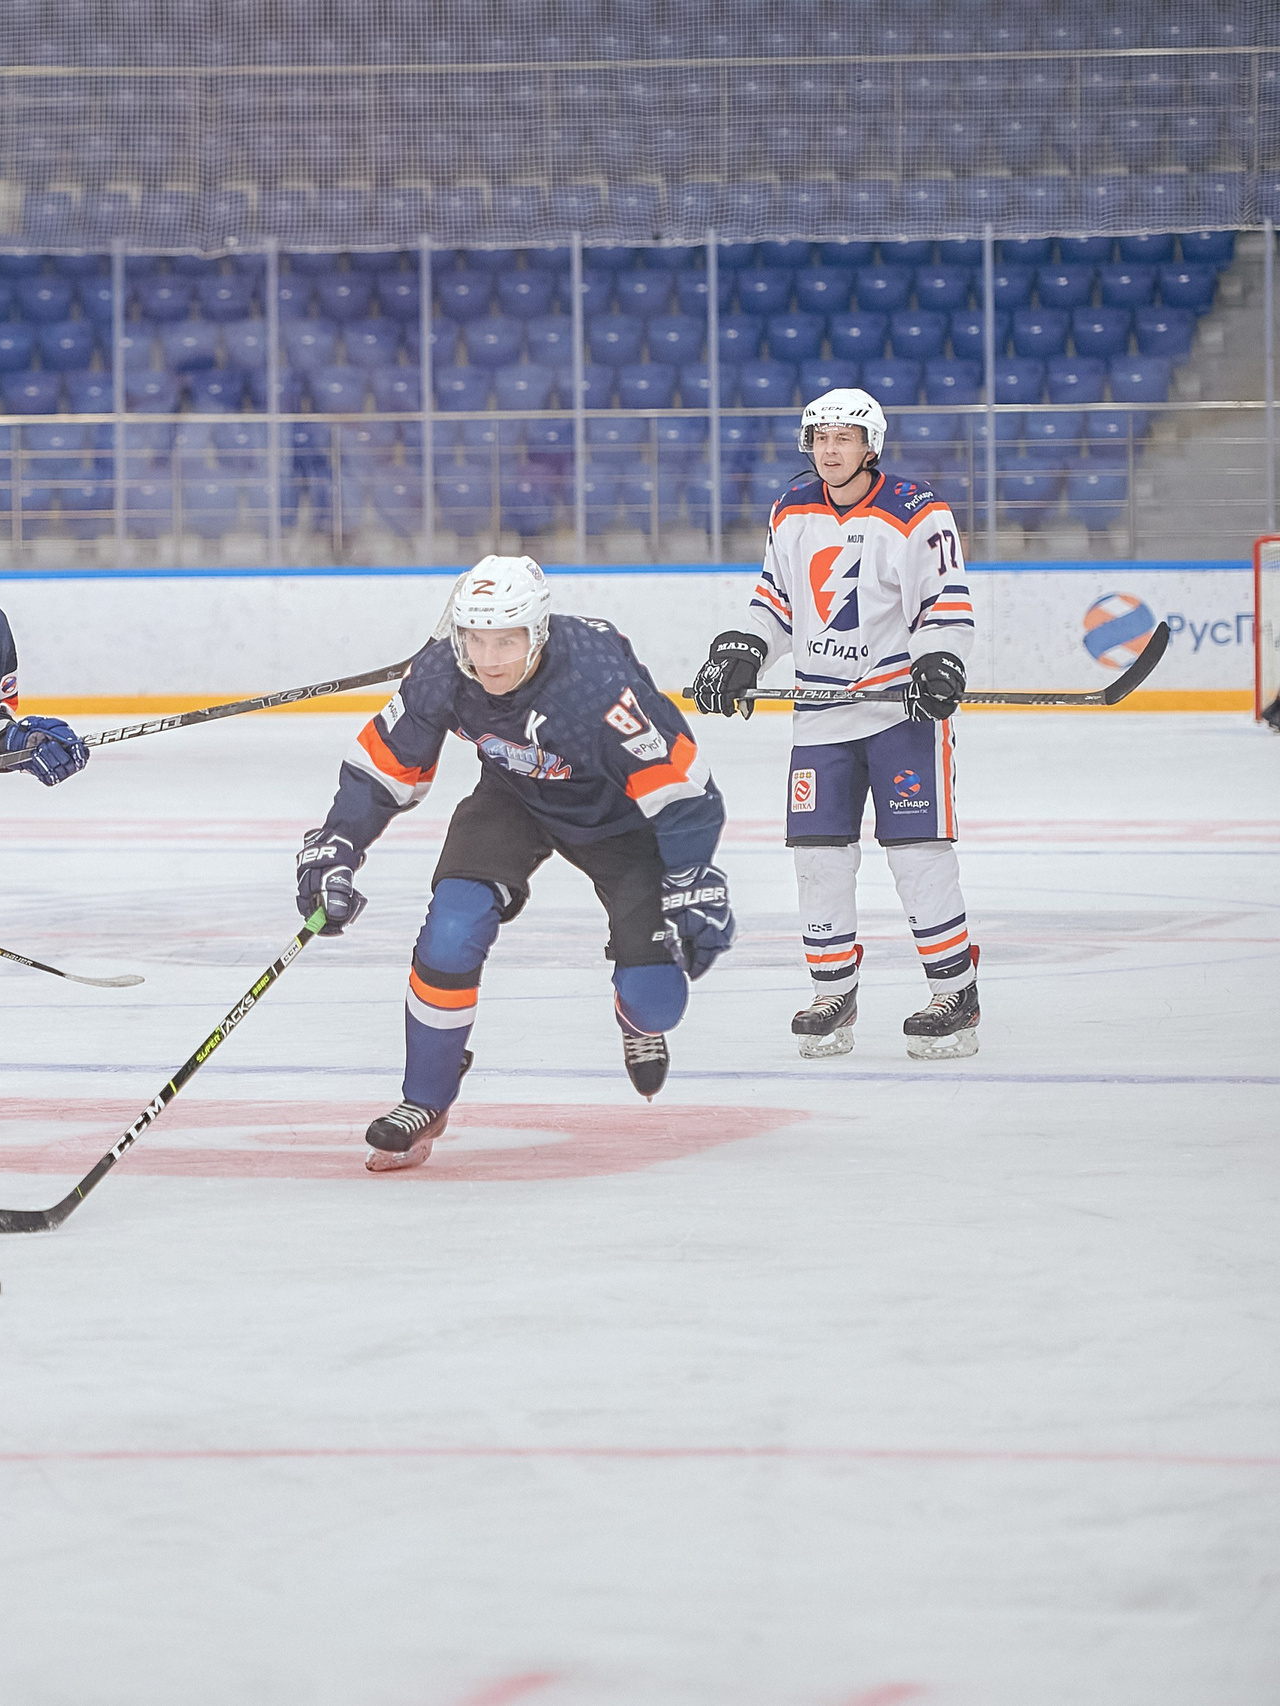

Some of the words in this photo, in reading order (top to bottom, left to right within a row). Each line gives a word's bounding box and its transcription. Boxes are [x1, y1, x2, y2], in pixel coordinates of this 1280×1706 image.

[927, 529, 959, 577] 77
[472, 579, 496, 596] Z
[1167, 613, 1255, 652] РусГ
[717, 641, 749, 652] MAD
[784, 689, 831, 699] ALPHA
[604, 686, 650, 736] 87
[889, 799, 930, 811] РусГидро
[661, 887, 727, 912] BAUER
[283, 943, 300, 962] CCM
[196, 1034, 222, 1063] SUPER
[219, 993, 256, 1038] TACKS
[111, 1094, 166, 1160] CCM
